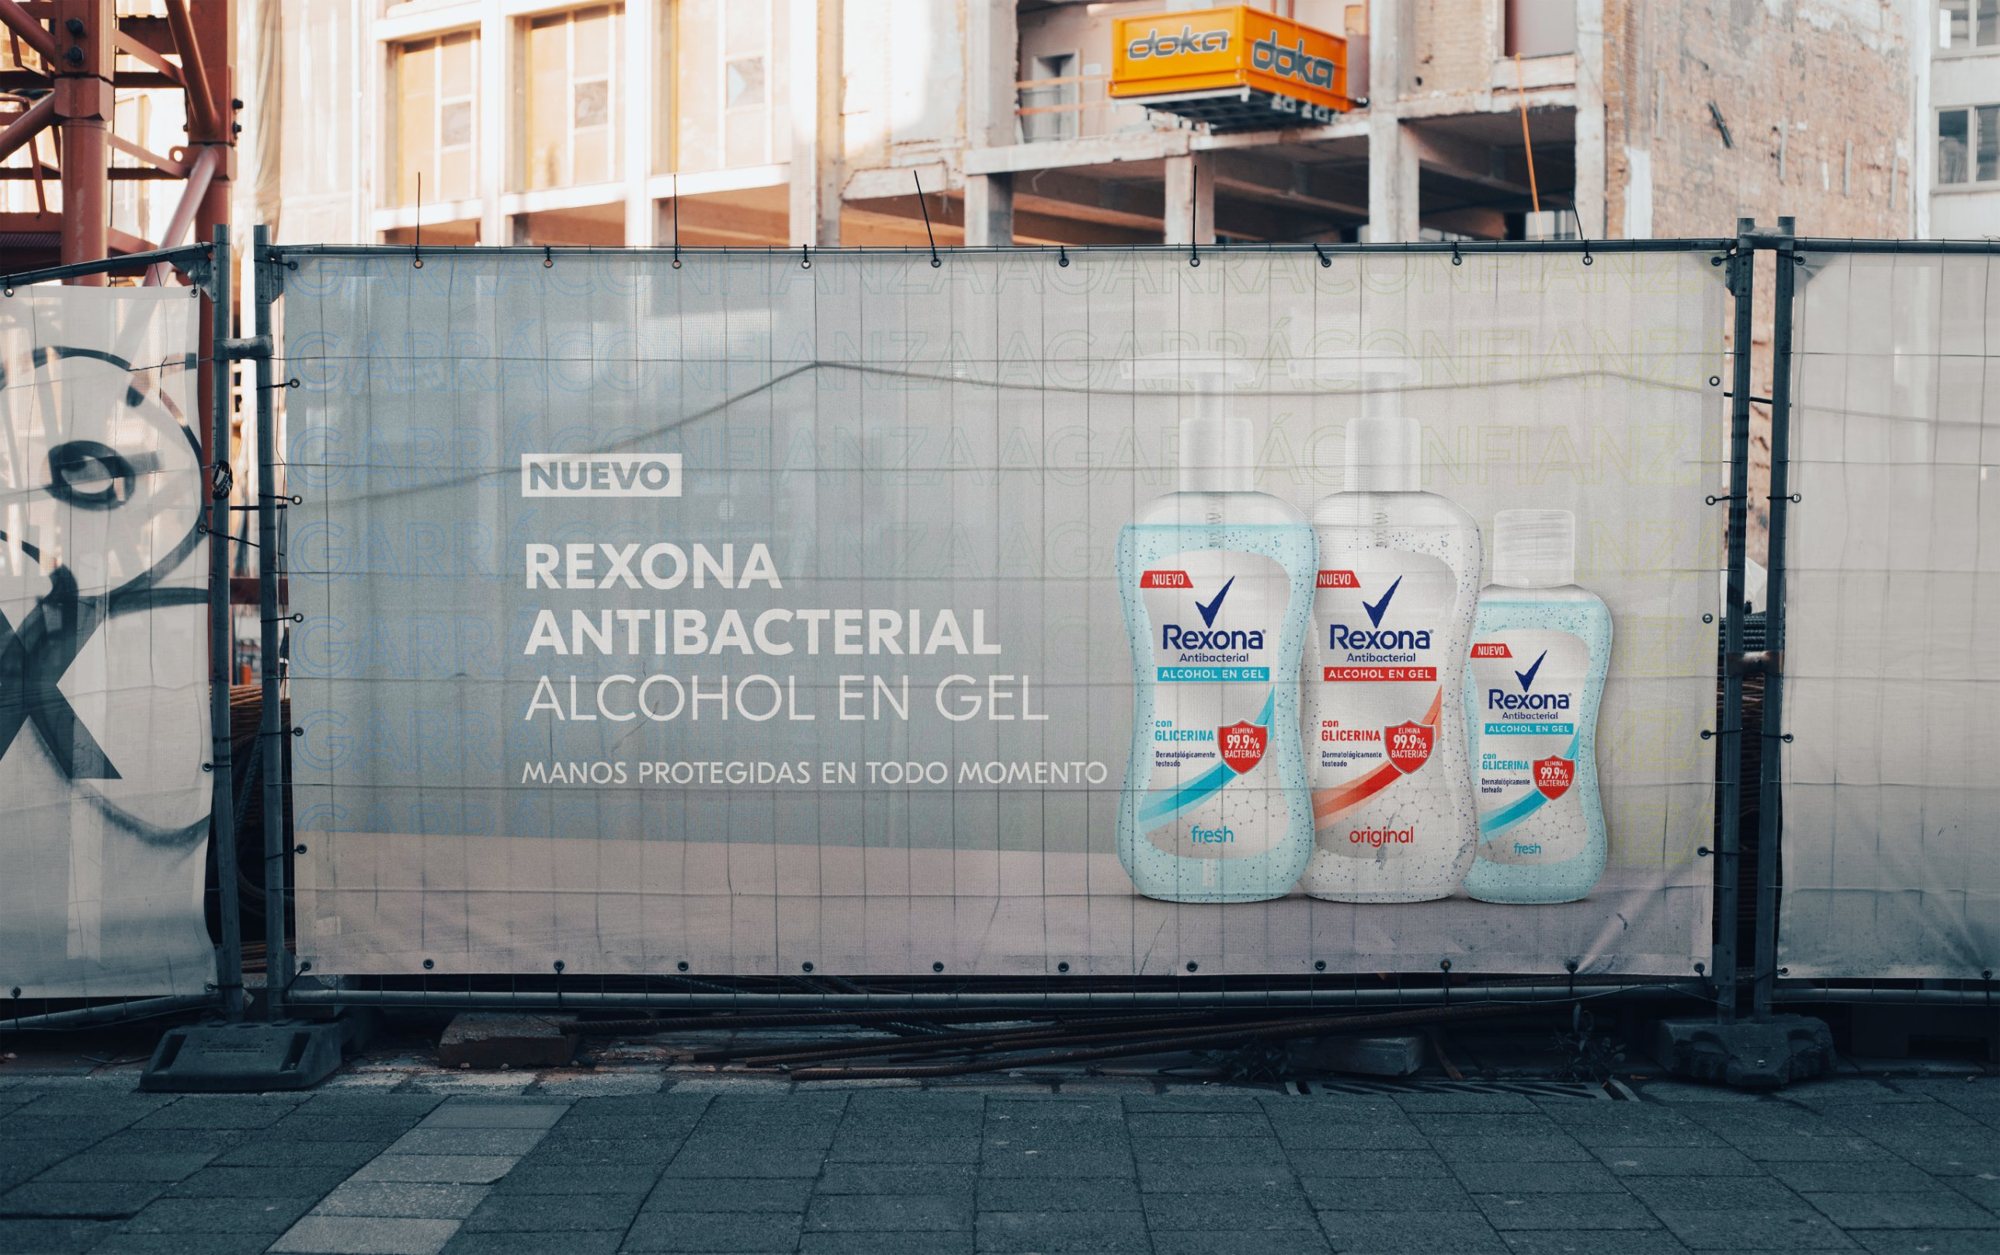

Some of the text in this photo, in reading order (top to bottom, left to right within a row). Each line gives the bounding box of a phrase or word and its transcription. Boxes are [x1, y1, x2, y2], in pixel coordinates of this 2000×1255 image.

[1128, 25, 1230, 60] doka
[1252, 30, 1335, 89] doka
[529, 460, 671, 491] NUEVO
[525, 543, 783, 589] REXONA
[1151, 573, 1185, 586] NUEVO
[1319, 573, 1351, 586] NUEVO
[524, 609, 1002, 655] ANTIBACTERIAL
[1477, 645, 1505, 656] NUEVO
[1179, 653, 1249, 662] Antibacterial
[1346, 652, 1416, 663] Antibacterial
[1162, 670, 1264, 679] ALCOHOL EN GEL
[1328, 669, 1432, 679] ALCOHOL EN GEL
[525, 674, 1049, 722] ALCOHOL EN GEL
[1502, 711, 1559, 720] Antibacterial
[1155, 720, 1172, 728] con
[1322, 720, 1339, 728] con
[1488, 725, 1569, 733] ALCOHOL EN GEL
[1155, 730, 1214, 741] GLICERINA
[1227, 734, 1260, 749] 99.9%
[1321, 730, 1381, 741] GLICERINA
[1393, 734, 1427, 749] 99.9%
[1224, 750, 1261, 759] BACTERIAS
[1391, 750, 1428, 759] BACTERIAS
[1482, 760, 1529, 770] GLICERINA
[521, 762, 1108, 785] MANOS PROTEGIDAS EN TODO MOMENTO
[1540, 766, 1569, 780] 99.9%
[1538, 779, 1569, 787] BACTERIAS
[1191, 826, 1234, 843] fresh
[1349, 826, 1414, 847] original
[1514, 842, 1542, 855] fresh
